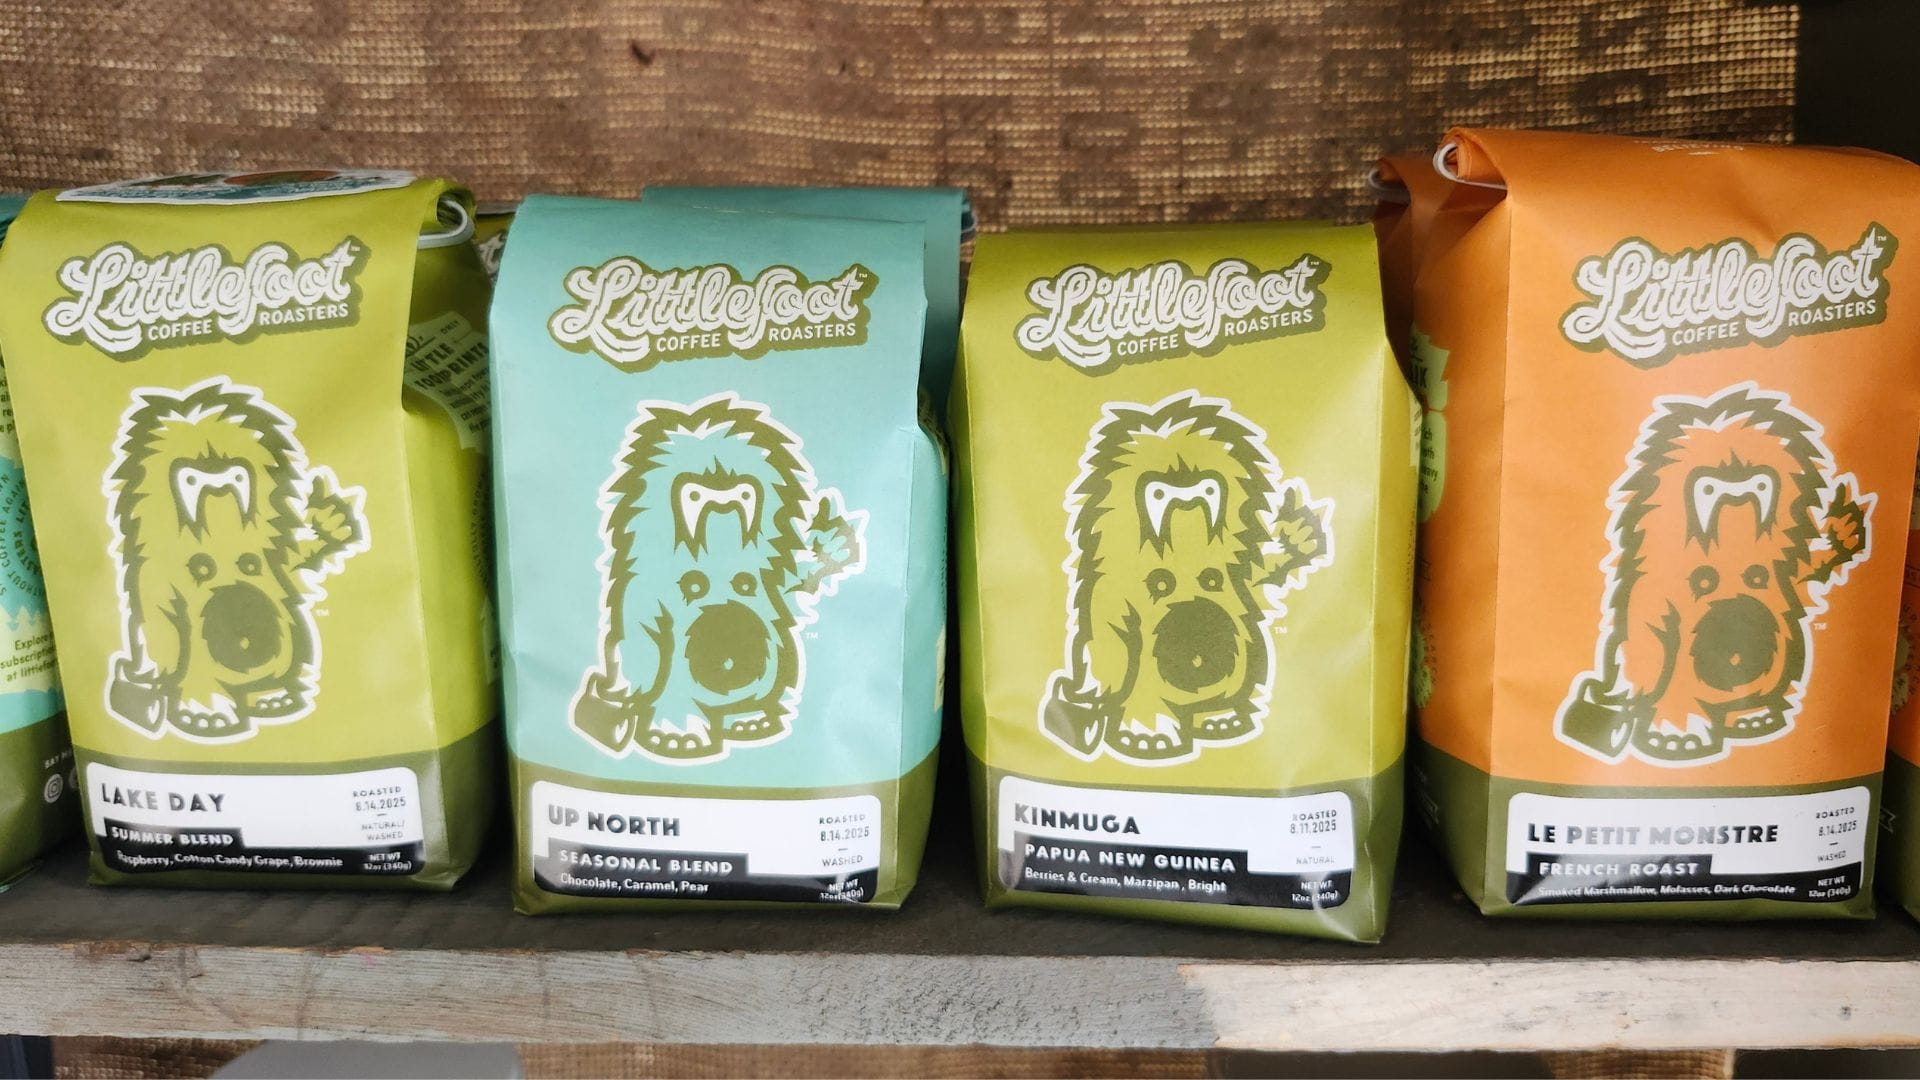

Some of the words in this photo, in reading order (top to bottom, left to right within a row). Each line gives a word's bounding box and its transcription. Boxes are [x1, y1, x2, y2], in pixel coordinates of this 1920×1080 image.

[46, 240, 356, 353] Littlefoot
[1563, 228, 1883, 359] Littlefoot
[552, 259, 865, 363] Littlefoot
[1018, 256, 1317, 367] Littlefoot
[148, 319, 213, 341] COFFEE
[259, 302, 349, 326] ROASTERS
[1672, 322, 1738, 345] COFFEE
[1788, 300, 1876, 326] ROASTERS
[656, 333, 721, 352] COFFEE
[769, 323, 856, 342] ROASTERS
[1117, 334, 1178, 356] COFFEE
[1224, 308, 1313, 336] ROASTERS
[6, 671, 17, 682] at
[102, 783, 159, 810] LAKE
[168, 792, 225, 813] DAY
[353, 786, 401, 797] ROASTED
[355, 797, 406, 811] 8.14.2025
[548, 804, 579, 826] UP
[588, 811, 680, 836] NORTH
[819, 814, 866, 824] ROASTED
[1014, 803, 1140, 835] KINMUGA
[1292, 809, 1337, 821] ROASTED
[1816, 807, 1854, 818] ROASTED
[820, 826, 869, 841] 8.14.2025
[1290, 819, 1337, 834] 8.11.2025
[1528, 823, 1555, 843] LE
[1566, 826, 1640, 844] PETIT
[1649, 825, 1778, 845] MONSTRE
[111, 826, 174, 845] SUMMER
[180, 833, 234, 846] BLEND
[367, 831, 403, 841] WASHED
[174, 853, 215, 864] Cotton
[215, 855, 251, 866] Candy
[254, 856, 293, 867] Grape,
[295, 856, 343, 867] Brownie
[369, 854, 385, 862] NET
[387, 851, 401, 860] WT
[560, 850, 661, 871] SEASONAL
[670, 859, 733, 874] BLEND
[822, 855, 863, 867] WASHED
[1024, 843, 1090, 862] PAPUA
[1099, 851, 1145, 867] NEW
[1154, 854, 1236, 872] GUINEA
[1296, 856, 1334, 865] NATURAL
[1818, 850, 1846, 862] WASHED
[1539, 862, 1619, 876] FRENCH
[1629, 862, 1699, 875] ROAST
[560, 873, 622, 890] Chocolate,
[624, 879, 679, 892] Caramel,
[681, 881, 709, 892] Pear
[829, 882, 844, 891] NET
[846, 879, 858, 888] WT
[1025, 867, 1064, 881] Berries
[1067, 872, 1077, 882] &
[1080, 873, 1121, 887] Cream,
[1188, 879, 1227, 893] Bright
[1301, 881, 1317, 890] NET
[1319, 880, 1333, 889] WT
[1818, 878, 1832, 887] NET
[1834, 875, 1845, 884] WT
[1291, 893, 1311, 902] 12oz
[1538, 887, 1581, 897] Smoked
[1584, 885, 1657, 896] Marshmallow,
[1660, 884, 1711, 894] Molasses,
[1714, 884, 1738, 893] Dark
[1741, 884, 1795, 894] Chocolate
